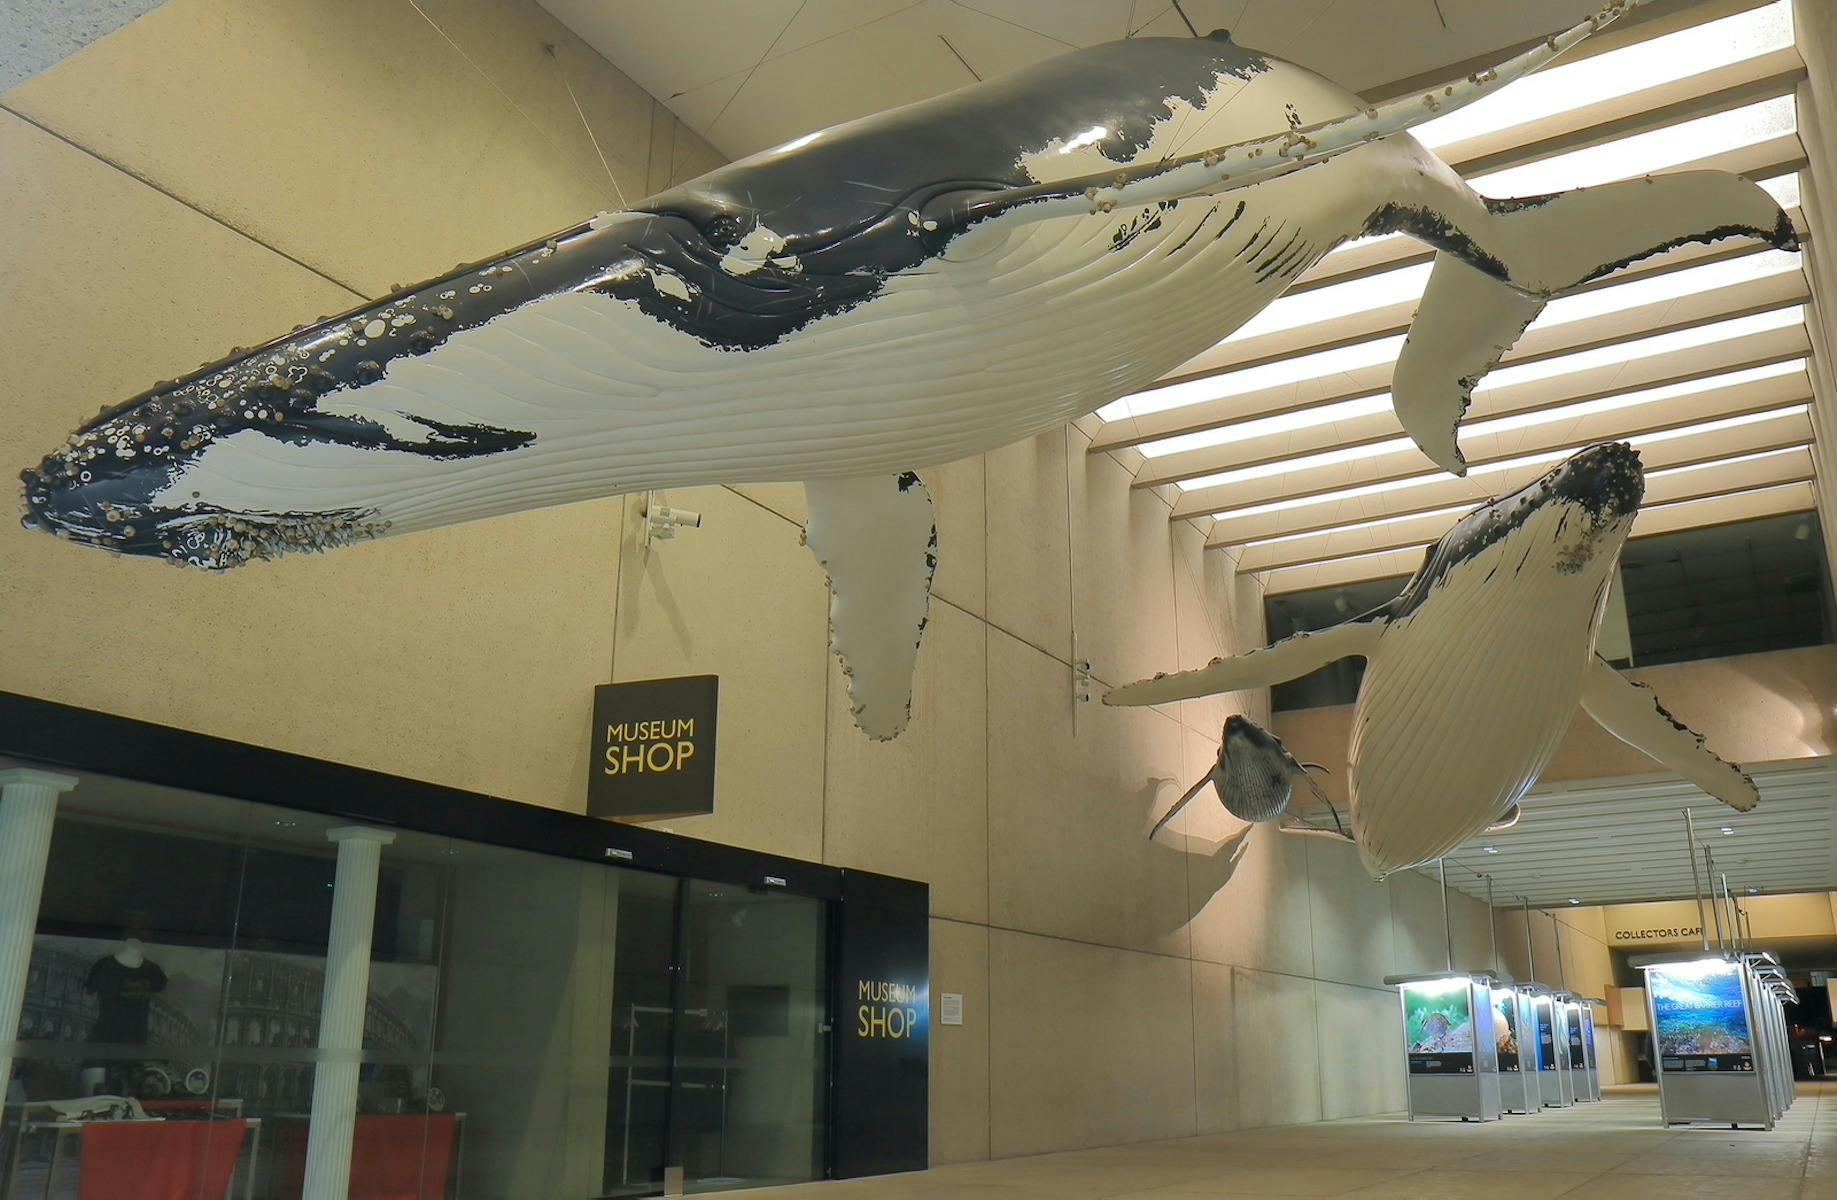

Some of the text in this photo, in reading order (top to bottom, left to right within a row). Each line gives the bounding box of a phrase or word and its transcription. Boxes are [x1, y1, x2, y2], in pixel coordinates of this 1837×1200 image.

[607, 718, 694, 743] MUSEUM
[604, 741, 695, 775] SHOP
[1615, 928, 1678, 939] COLLECTORS
[858, 980, 916, 1003] MUSEUM
[1657, 1003, 1671, 1011] THE
[1672, 1002, 1693, 1011] GREAT
[1724, 1000, 1743, 1008] REEF
[858, 1005, 917, 1038] SHOP
